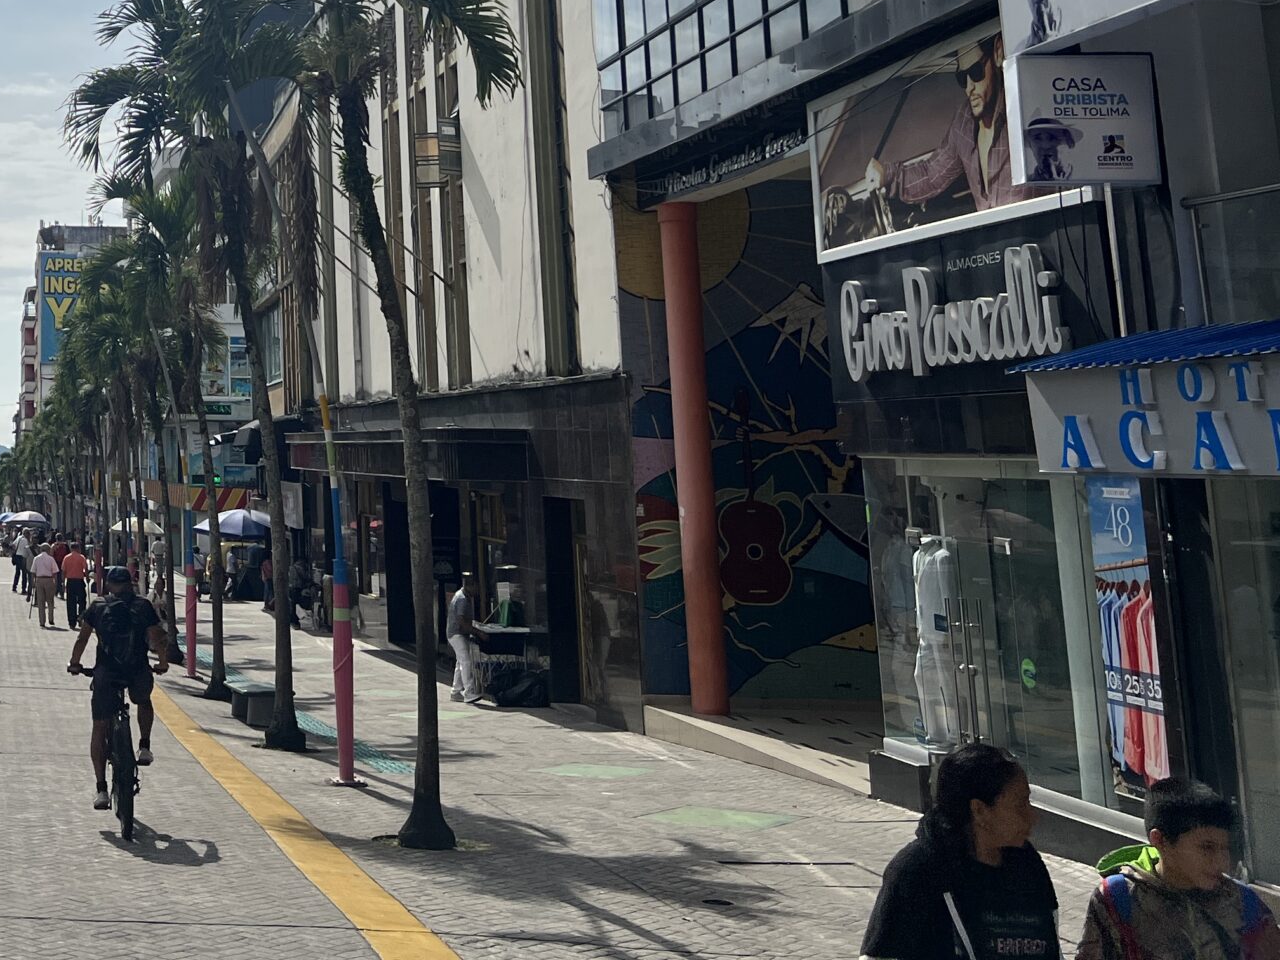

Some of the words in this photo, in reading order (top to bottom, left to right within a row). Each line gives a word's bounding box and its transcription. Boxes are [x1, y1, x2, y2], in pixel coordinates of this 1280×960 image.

[1051, 77, 1107, 92] CASA
[1052, 93, 1129, 106] URIBISTA
[1053, 107, 1079, 117] DEL
[1081, 107, 1130, 117] TOLIMA
[45, 257, 93, 272] APRE
[946, 250, 1001, 273] ALMACENES
[1104, 503, 1133, 547] 48
[1124, 673, 1140, 695] 25
[1147, 678, 1162, 699] 35
